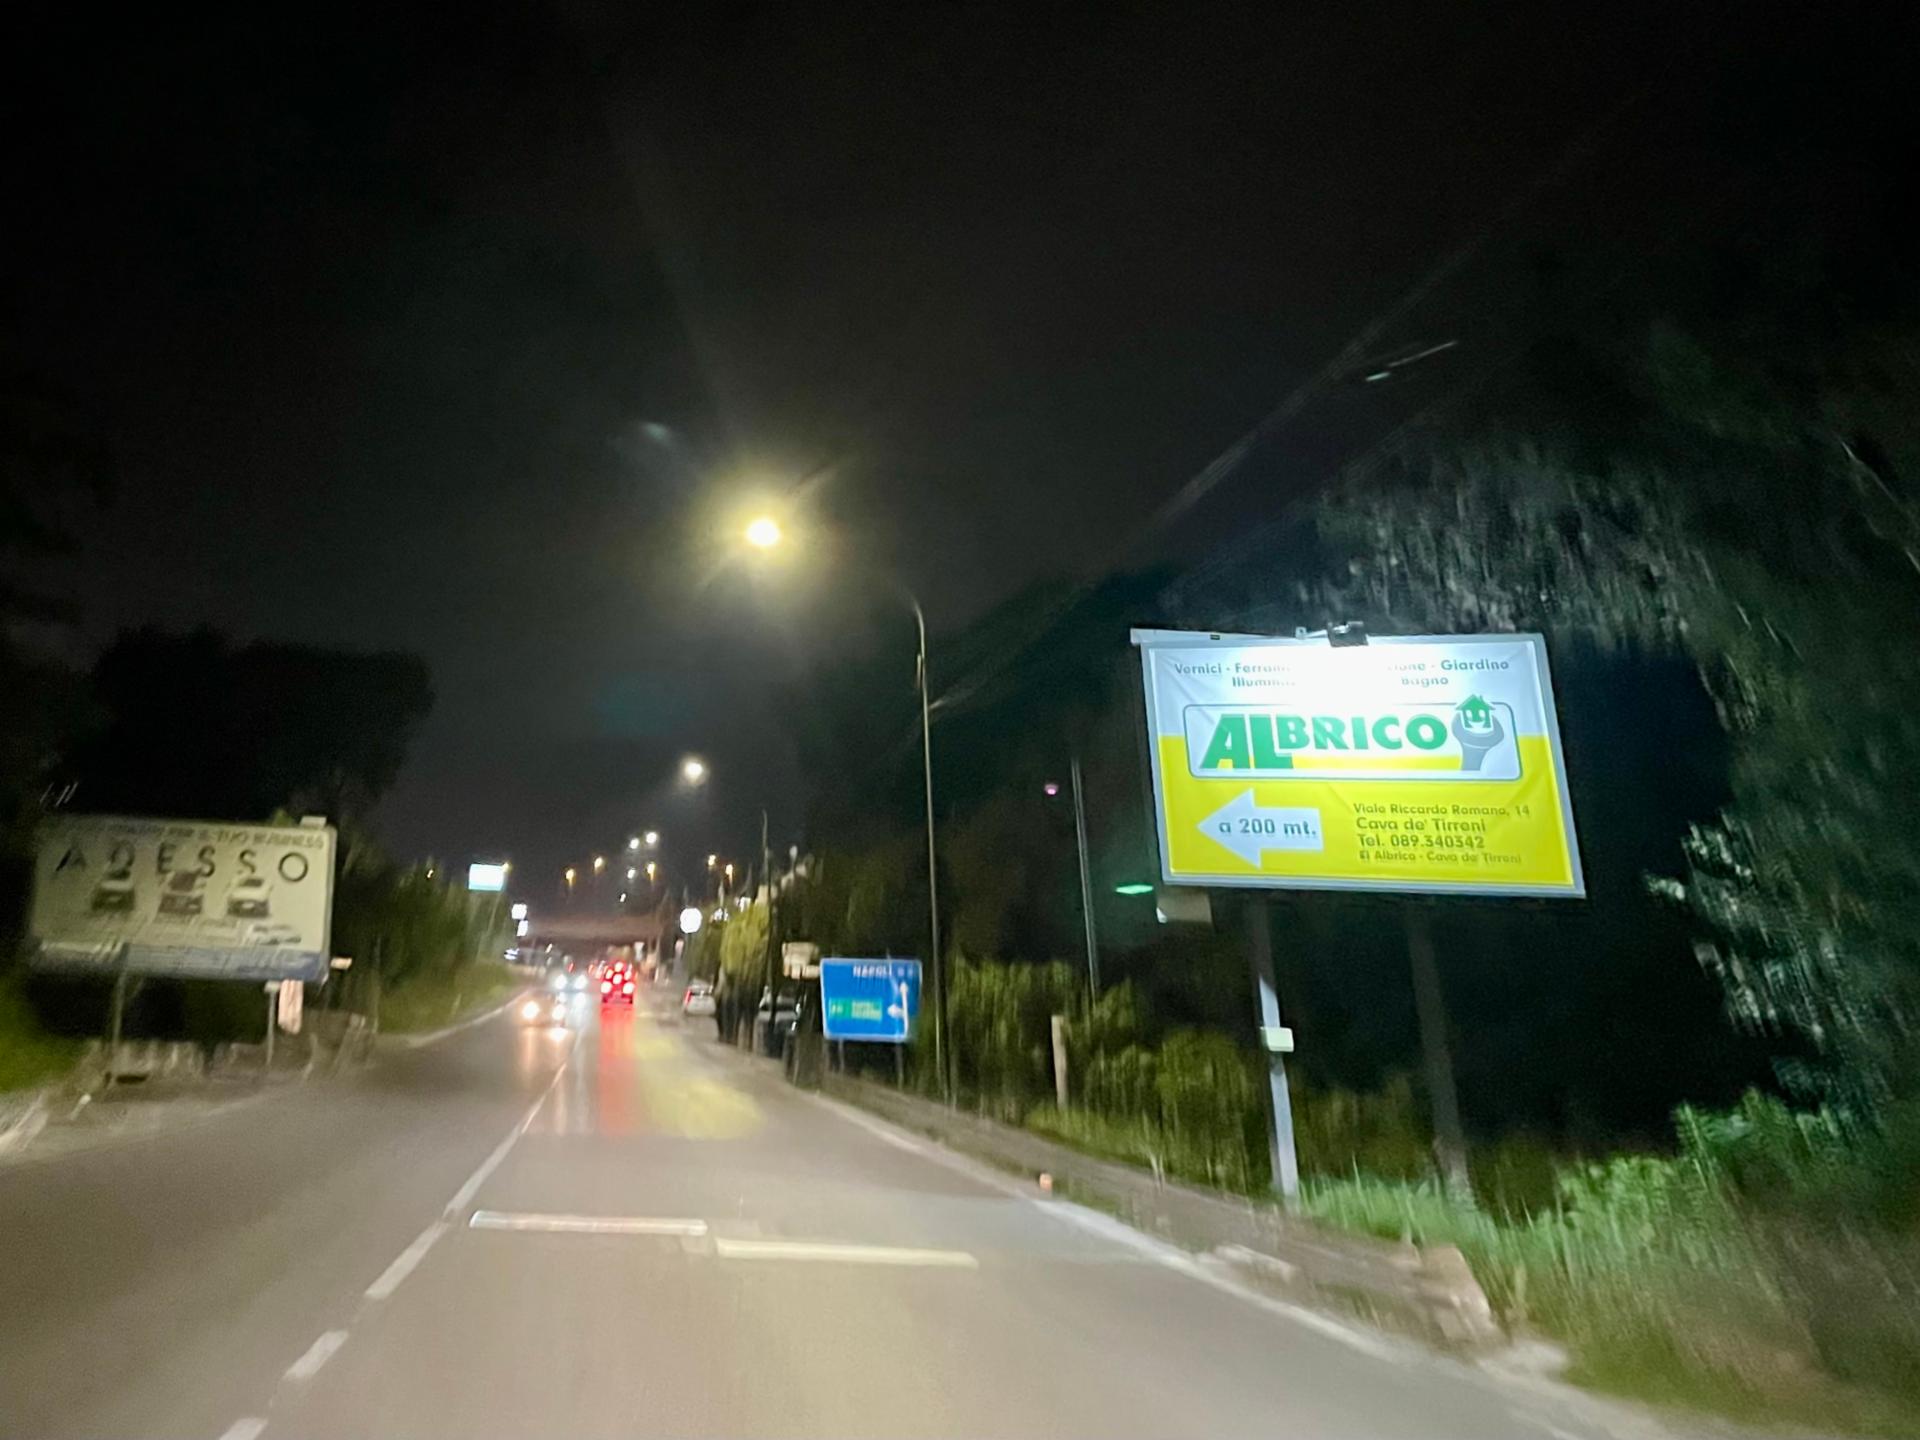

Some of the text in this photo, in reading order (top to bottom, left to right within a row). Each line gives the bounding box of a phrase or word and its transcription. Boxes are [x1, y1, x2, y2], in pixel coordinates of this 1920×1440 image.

[1174, 663, 1222, 675] Vernici
[1440, 659, 1510, 671] Giardino
[1200, 713, 1448, 769] ALBRICO
[1353, 803, 1386, 814] Viale
[1390, 803, 1448, 815] Riccardo
[1515, 805, 1530, 817] 14
[1218, 818, 1317, 835] a 200 mt.
[1356, 817, 1399, 831] Cava
[1432, 818, 1487, 833] Tirreni
[1357, 834, 1485, 849] Tel. 089.340342
[1374, 850, 1417, 861] Albrico
[1427, 851, 1458, 862] Cava
[1484, 852, 1523, 864] Tirreni
